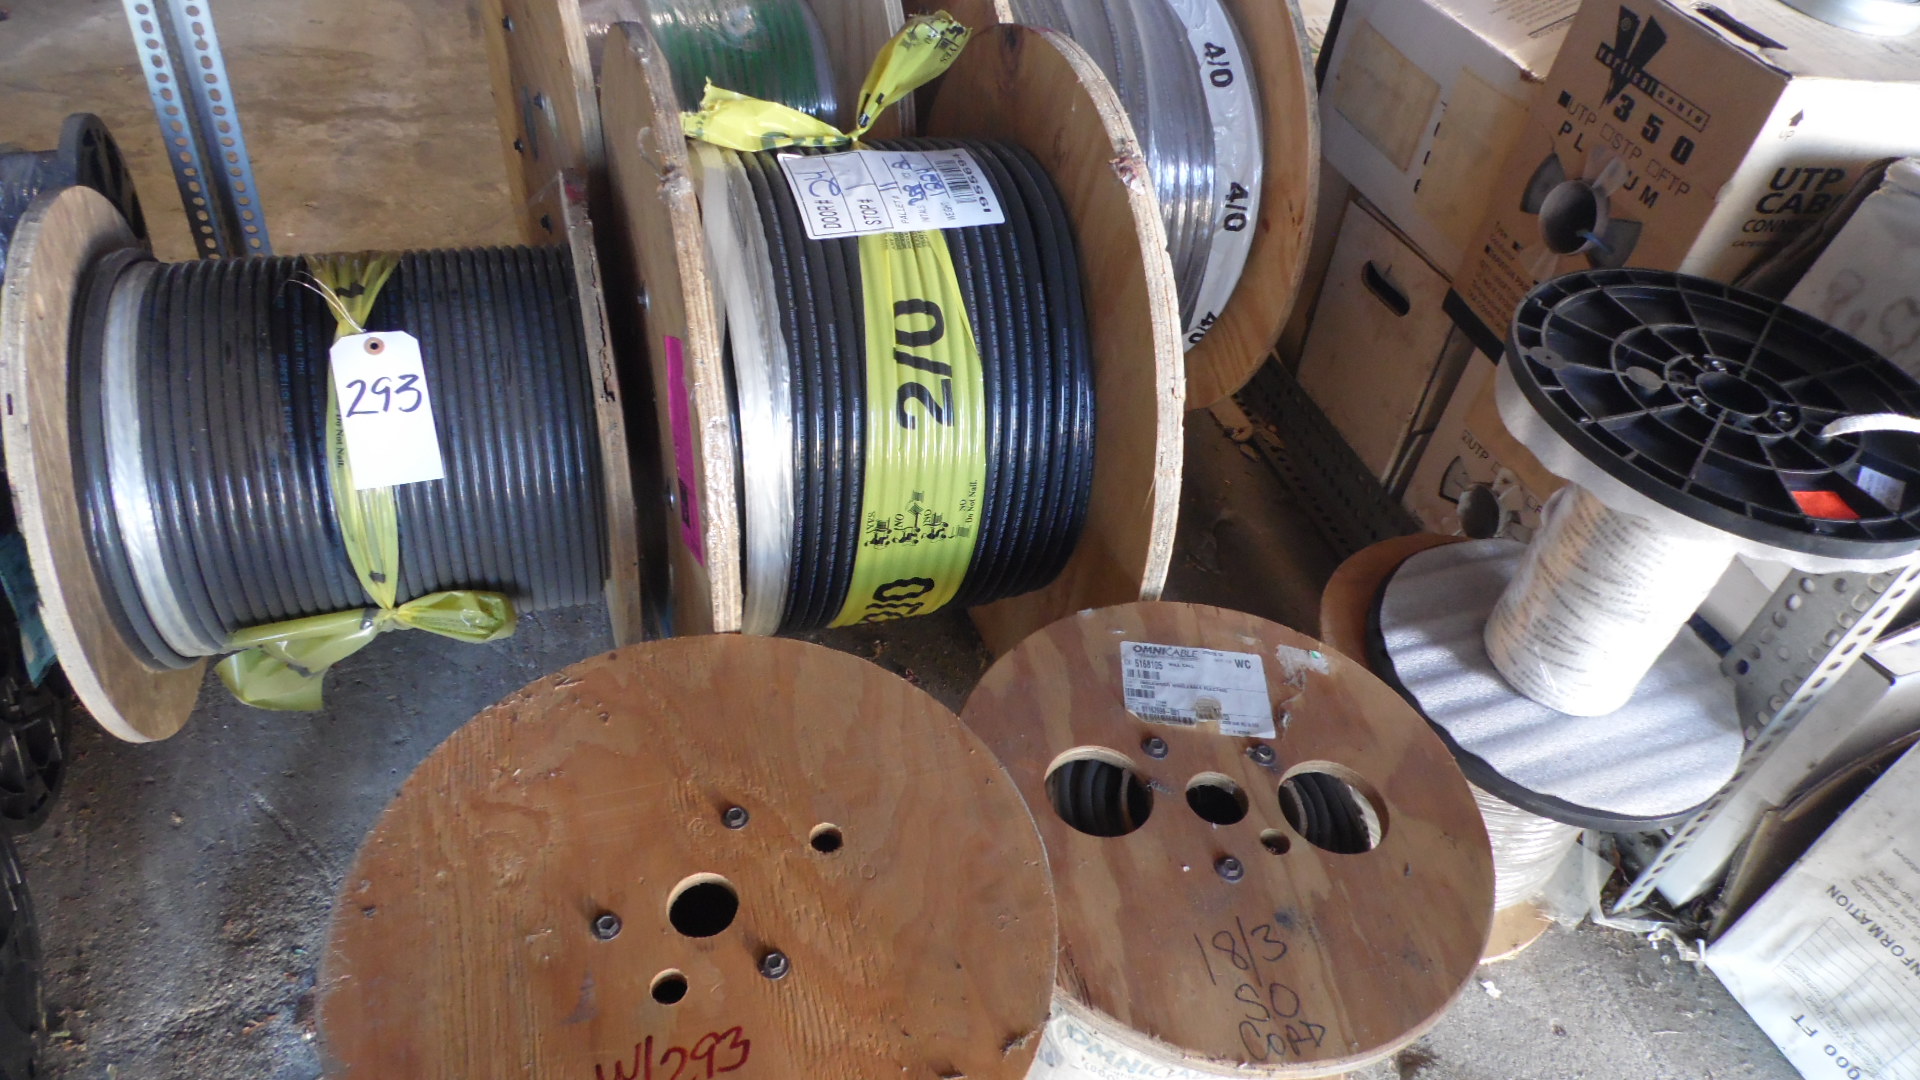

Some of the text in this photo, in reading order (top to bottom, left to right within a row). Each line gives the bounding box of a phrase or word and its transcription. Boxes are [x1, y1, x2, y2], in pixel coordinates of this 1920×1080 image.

[1204, 42, 1234, 88] 4/0
[1769, 167, 1846, 191] UTP
[1223, 181, 1250, 233] 4/0
[893, 298, 955, 430] 2/0
[345, 373, 423, 419] 293
[1234, 658, 1252, 670] WC
[1193, 915, 1288, 987] 18/3
